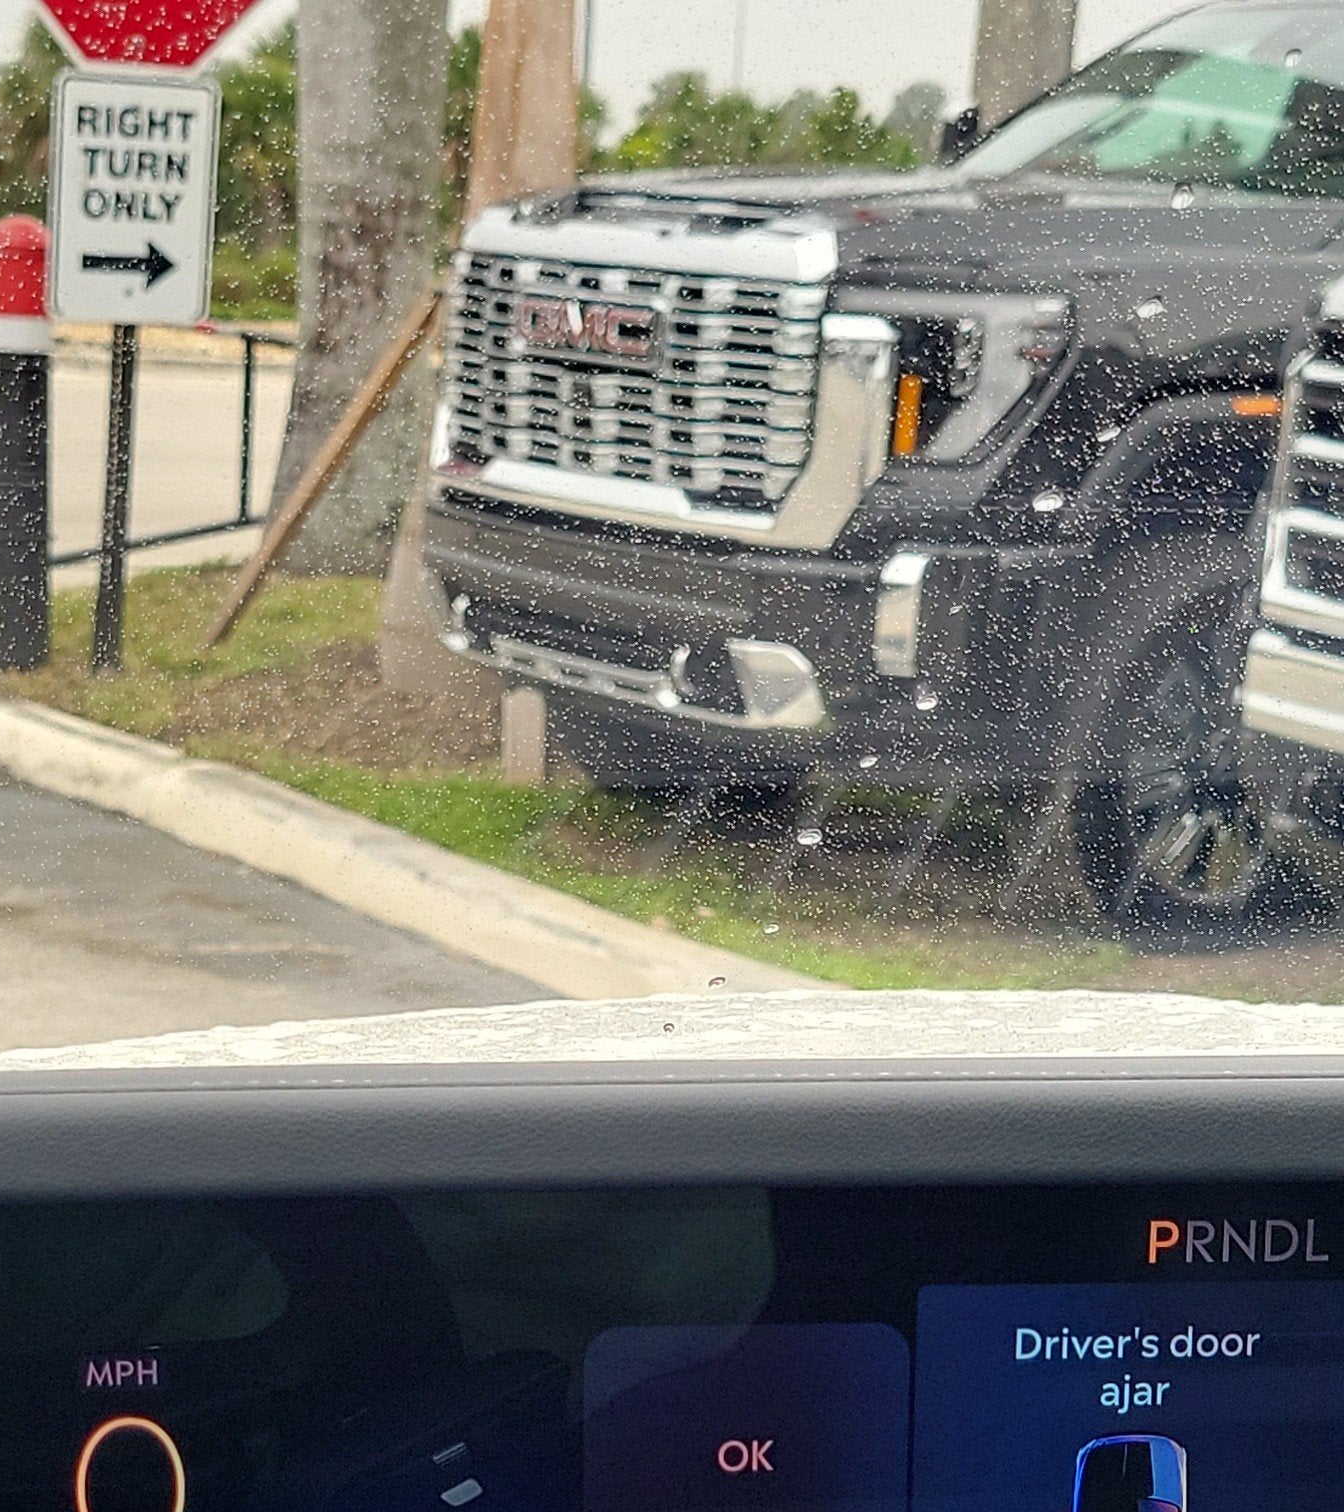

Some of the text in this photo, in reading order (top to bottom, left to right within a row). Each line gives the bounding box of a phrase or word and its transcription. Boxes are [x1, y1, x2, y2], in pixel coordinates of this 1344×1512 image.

[77, 106, 194, 139] RIGHT
[85, 149, 188, 180] TURN
[84, 189, 180, 221] ONLY
[520, 301, 656, 355] GMC
[1014, 1326, 1260, 1361] Driver's door
[86, 1359, 159, 1387] MPH
[1099, 1375, 1170, 1415] ajar
[717, 1440, 775, 1473] OK
